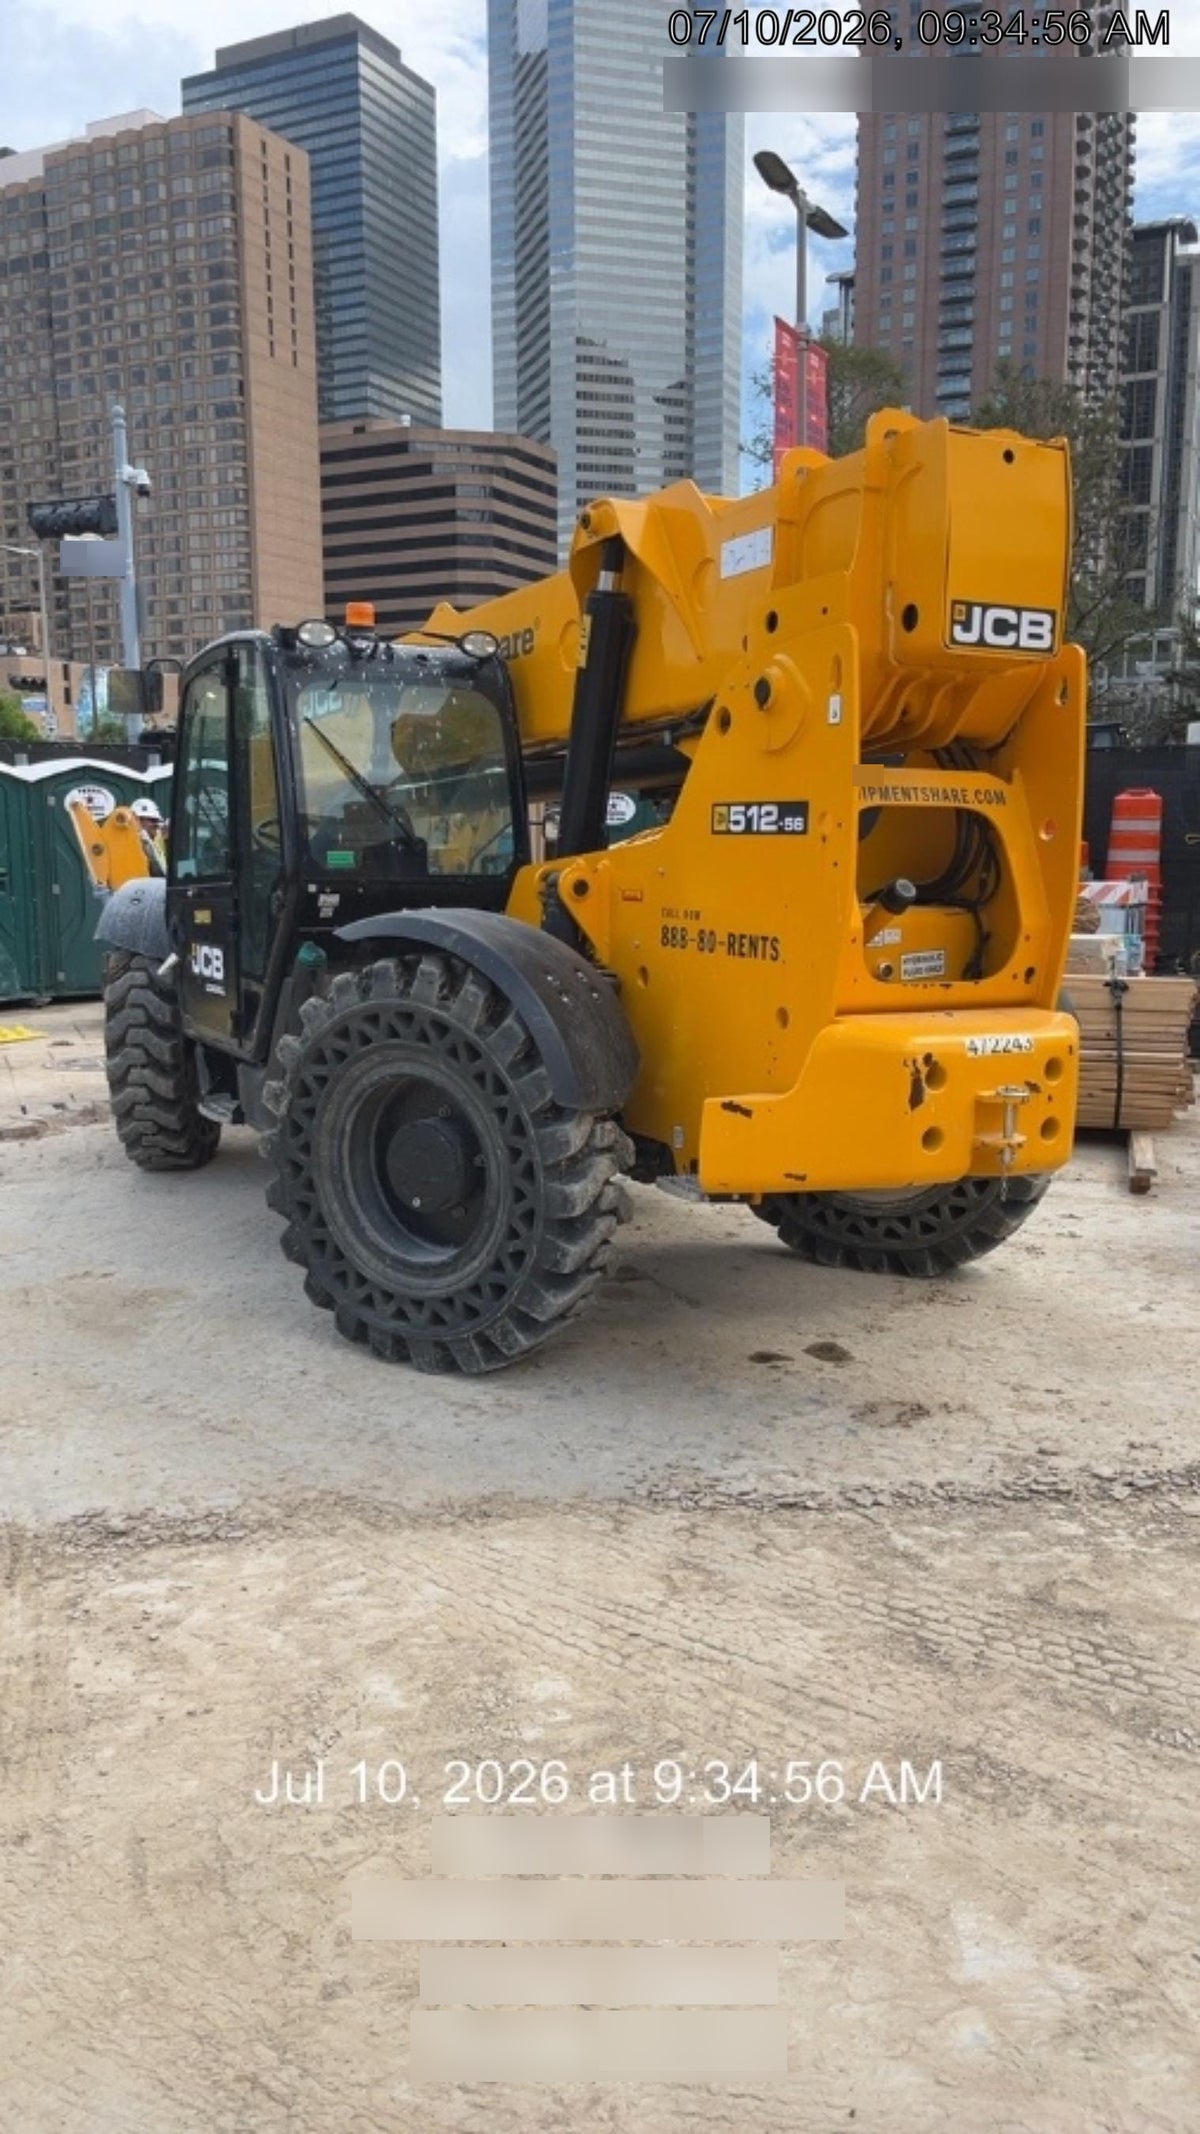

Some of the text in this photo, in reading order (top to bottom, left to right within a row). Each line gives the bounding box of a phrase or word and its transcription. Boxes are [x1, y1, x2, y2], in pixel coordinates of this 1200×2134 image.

[953, 606, 1053, 649] JCB
[191, 943, 224, 980] JCB
[661, 925, 779, 961] 888-80-RENTS
